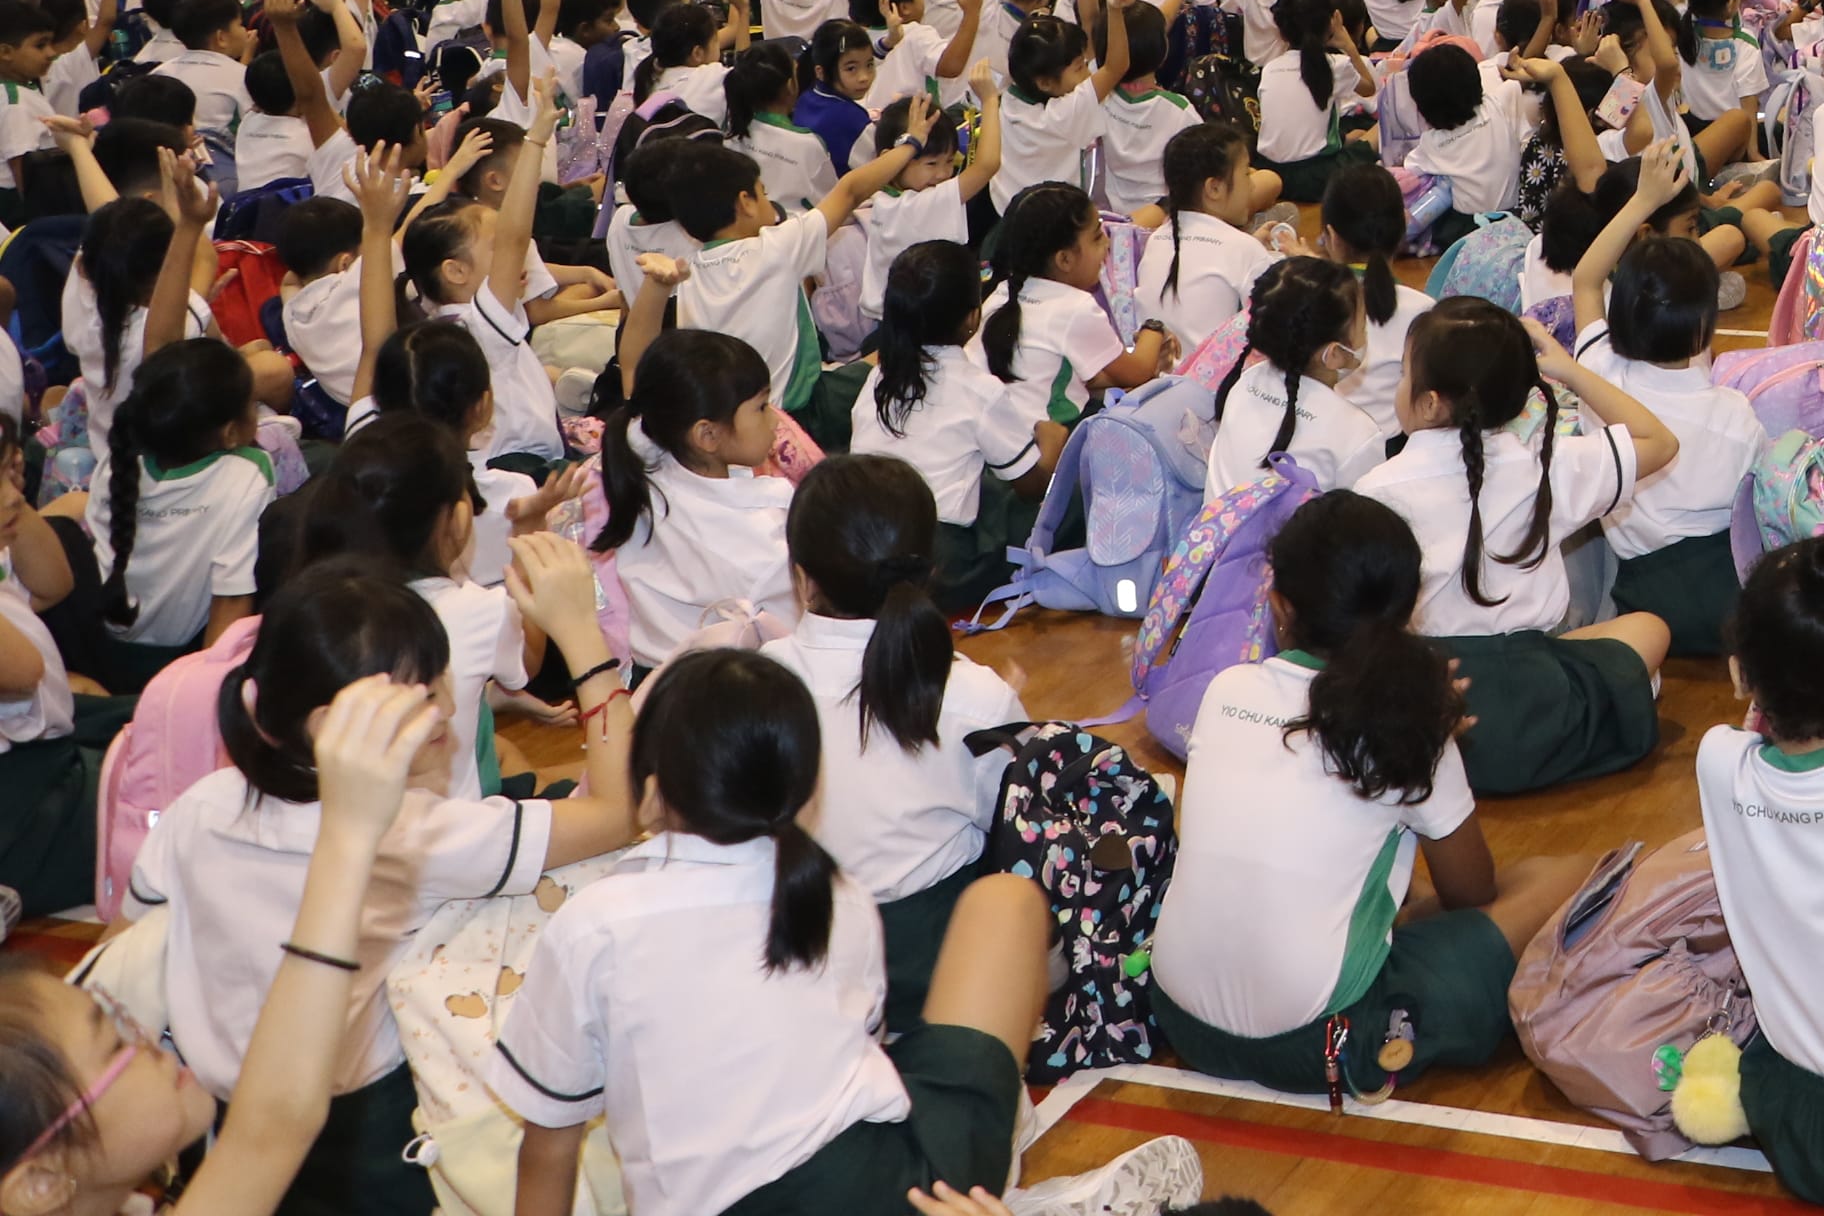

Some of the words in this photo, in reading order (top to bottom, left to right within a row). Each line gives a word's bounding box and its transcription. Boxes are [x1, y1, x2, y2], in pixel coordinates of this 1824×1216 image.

[1221, 704, 1236, 718] YIO
[1238, 708, 1263, 725] CHU
[1746, 804, 1775, 819] CHU
[1773, 810, 1811, 825] KANG
